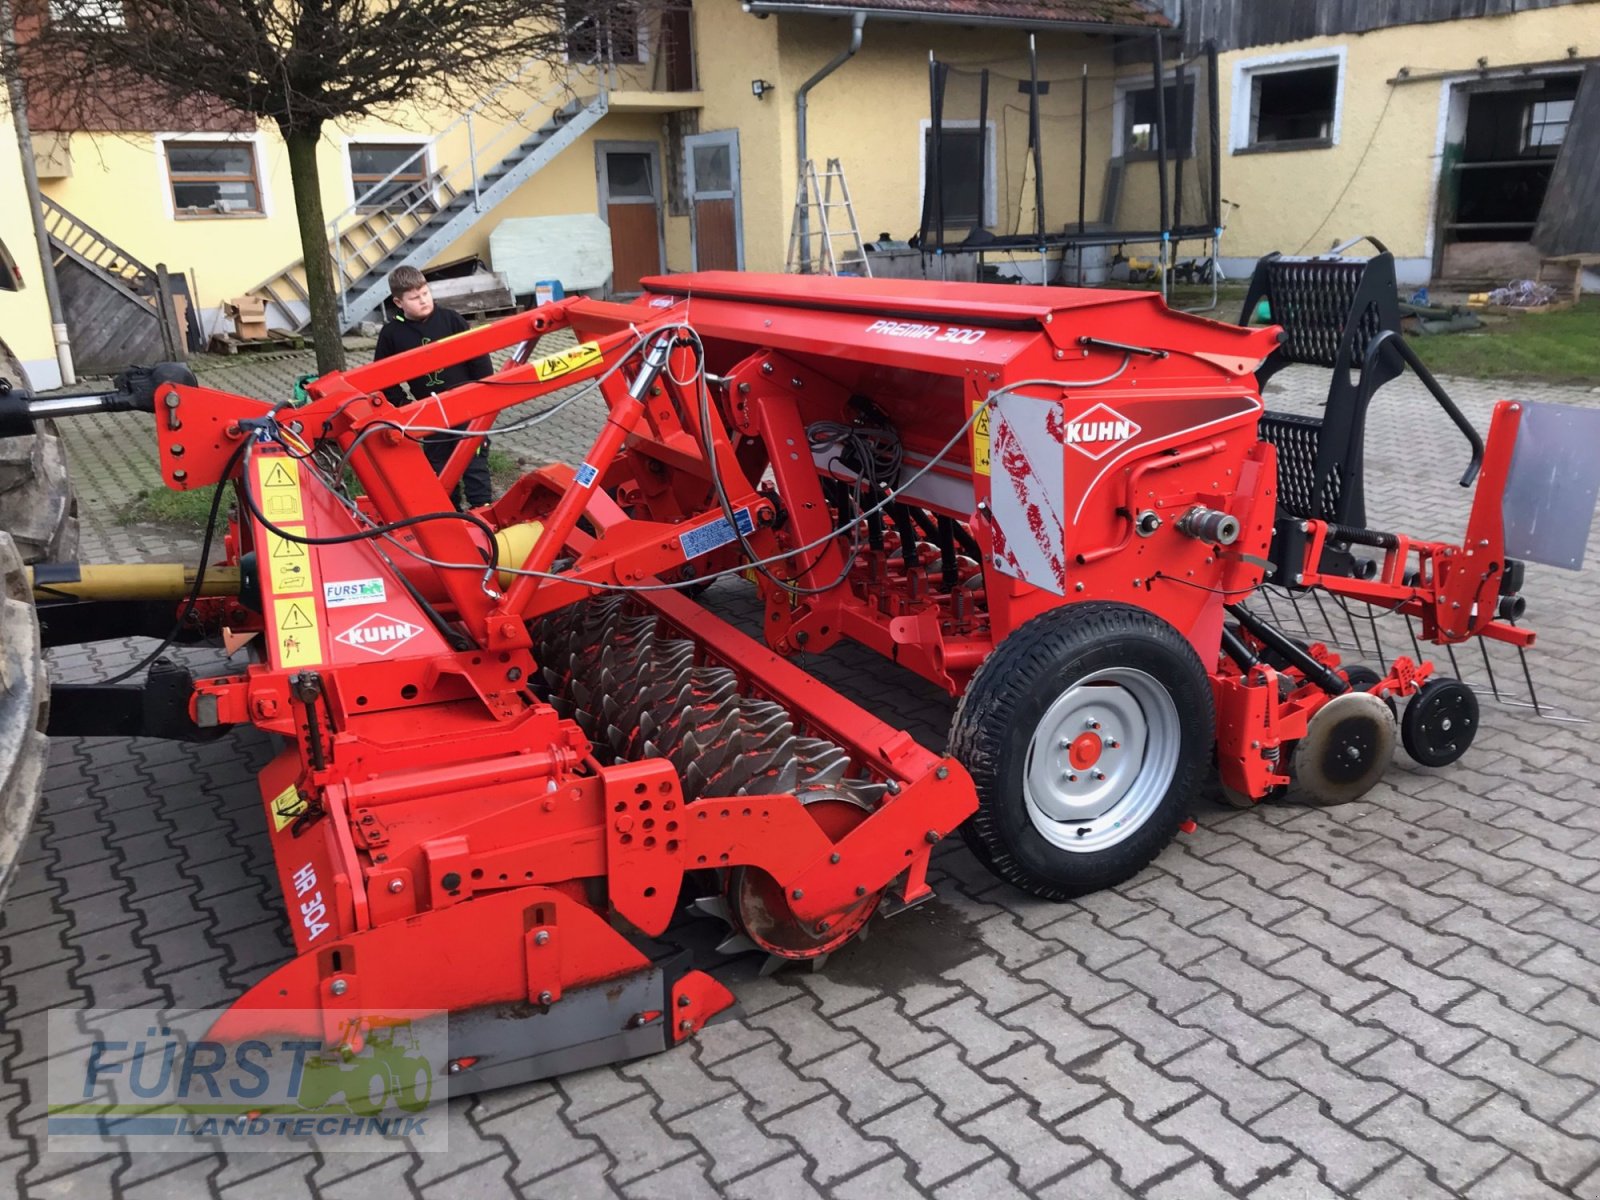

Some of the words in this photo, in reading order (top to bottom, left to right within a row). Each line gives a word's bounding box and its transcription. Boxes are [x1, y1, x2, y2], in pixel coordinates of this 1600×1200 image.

[865, 320, 940, 339] PREMIA
[935, 328, 986, 345] 300
[1067, 421, 1130, 443] KUHN
[348, 624, 412, 644] KUHN
[292, 862, 317, 898] HR
[300, 891, 330, 942] 304
